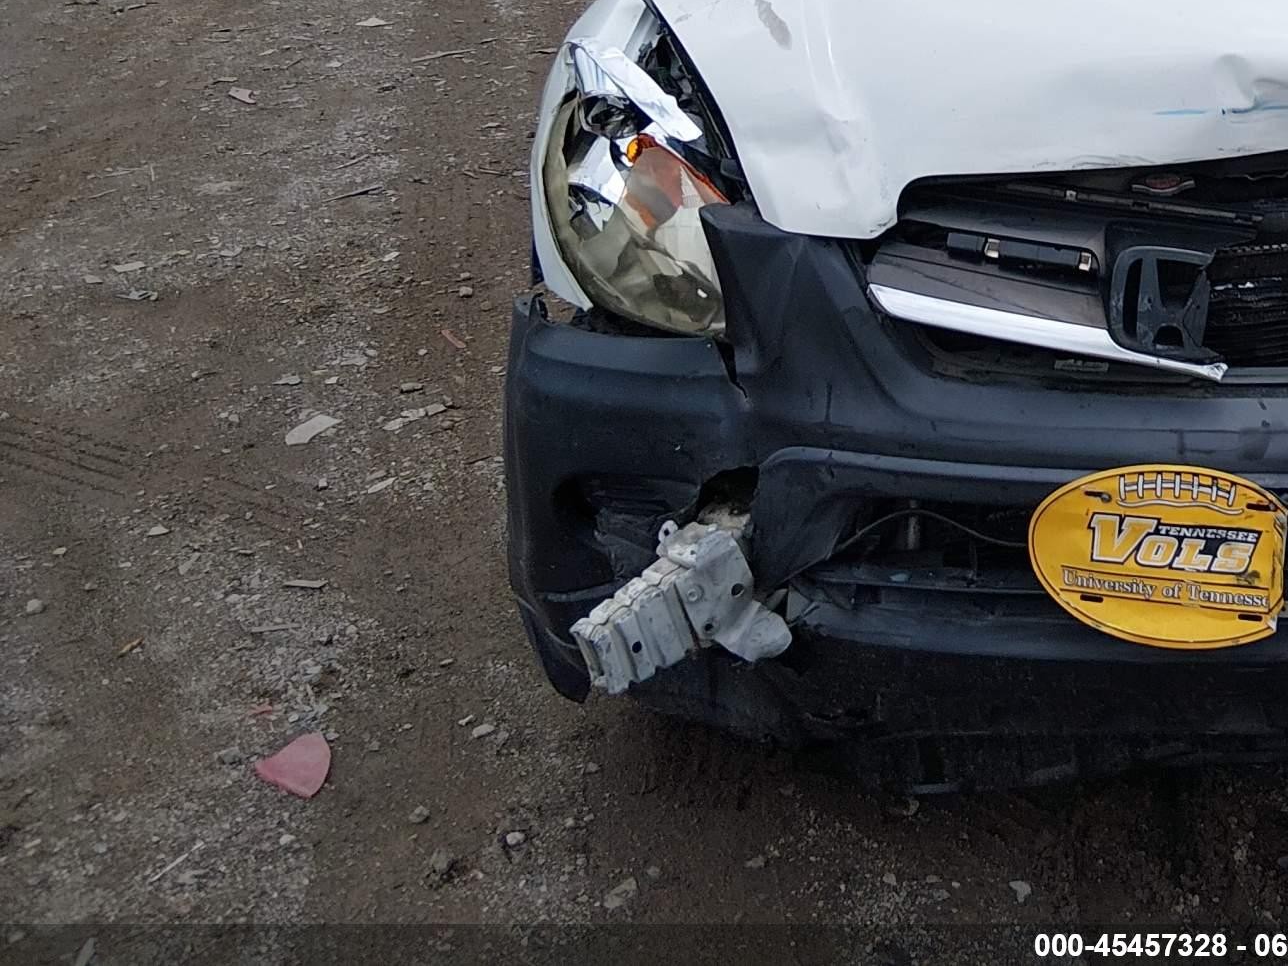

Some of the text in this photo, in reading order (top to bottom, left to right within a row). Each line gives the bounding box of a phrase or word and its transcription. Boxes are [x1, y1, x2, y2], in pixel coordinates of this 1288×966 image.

[1089, 513, 1256, 573] VOLS
[1158, 525, 1259, 542] TENNESSEE
[1063, 569, 1156, 599] University
[1162, 583, 1183, 598] of
